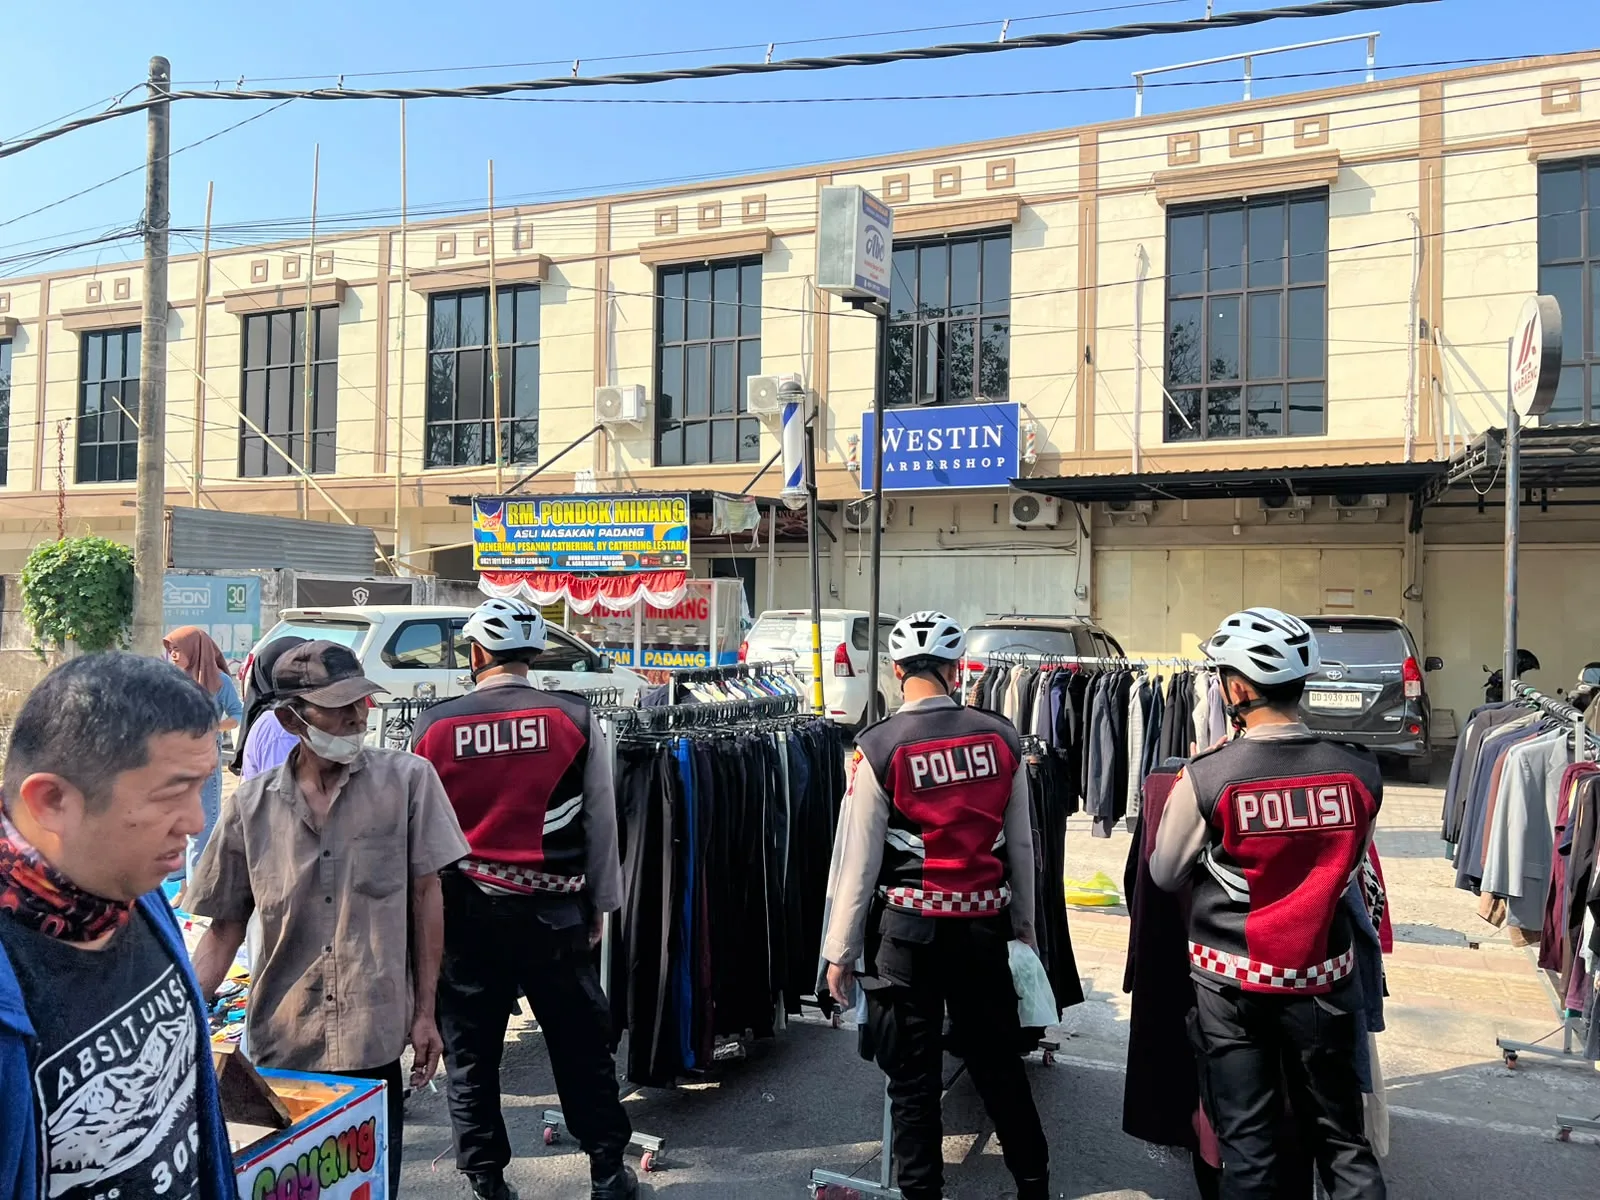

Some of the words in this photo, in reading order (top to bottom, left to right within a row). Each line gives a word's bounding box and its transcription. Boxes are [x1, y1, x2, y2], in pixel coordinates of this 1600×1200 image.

[882, 424, 1004, 453] WESTIN
[885, 456, 1006, 472] ARBERSHOP
[507, 501, 538, 525] RM.
[540, 499, 613, 525] PONDOK
[614, 498, 686, 524] MINANG
[514, 529, 538, 539] ASLI
[541, 528, 595, 539] MASAKAN
[598, 527, 645, 538] PADANG
[478, 541, 517, 552] MENERIMA
[517, 541, 550, 552] PESANAN
[596, 540, 607, 551] BY
[608, 540, 652, 551] CATHERING
[653, 540, 686, 551] LESTARI
[228, 586, 245, 604] 30
[644, 651, 707, 667] PADANG
[1311, 693, 1322, 702] DD
[1323, 693, 1343, 702] 1939
[455, 717, 546, 757] POLISI
[909, 743, 997, 788] POLISI
[1237, 784, 1352, 832] POLISI
[57, 973, 187, 1099] ABSLT.UNS
